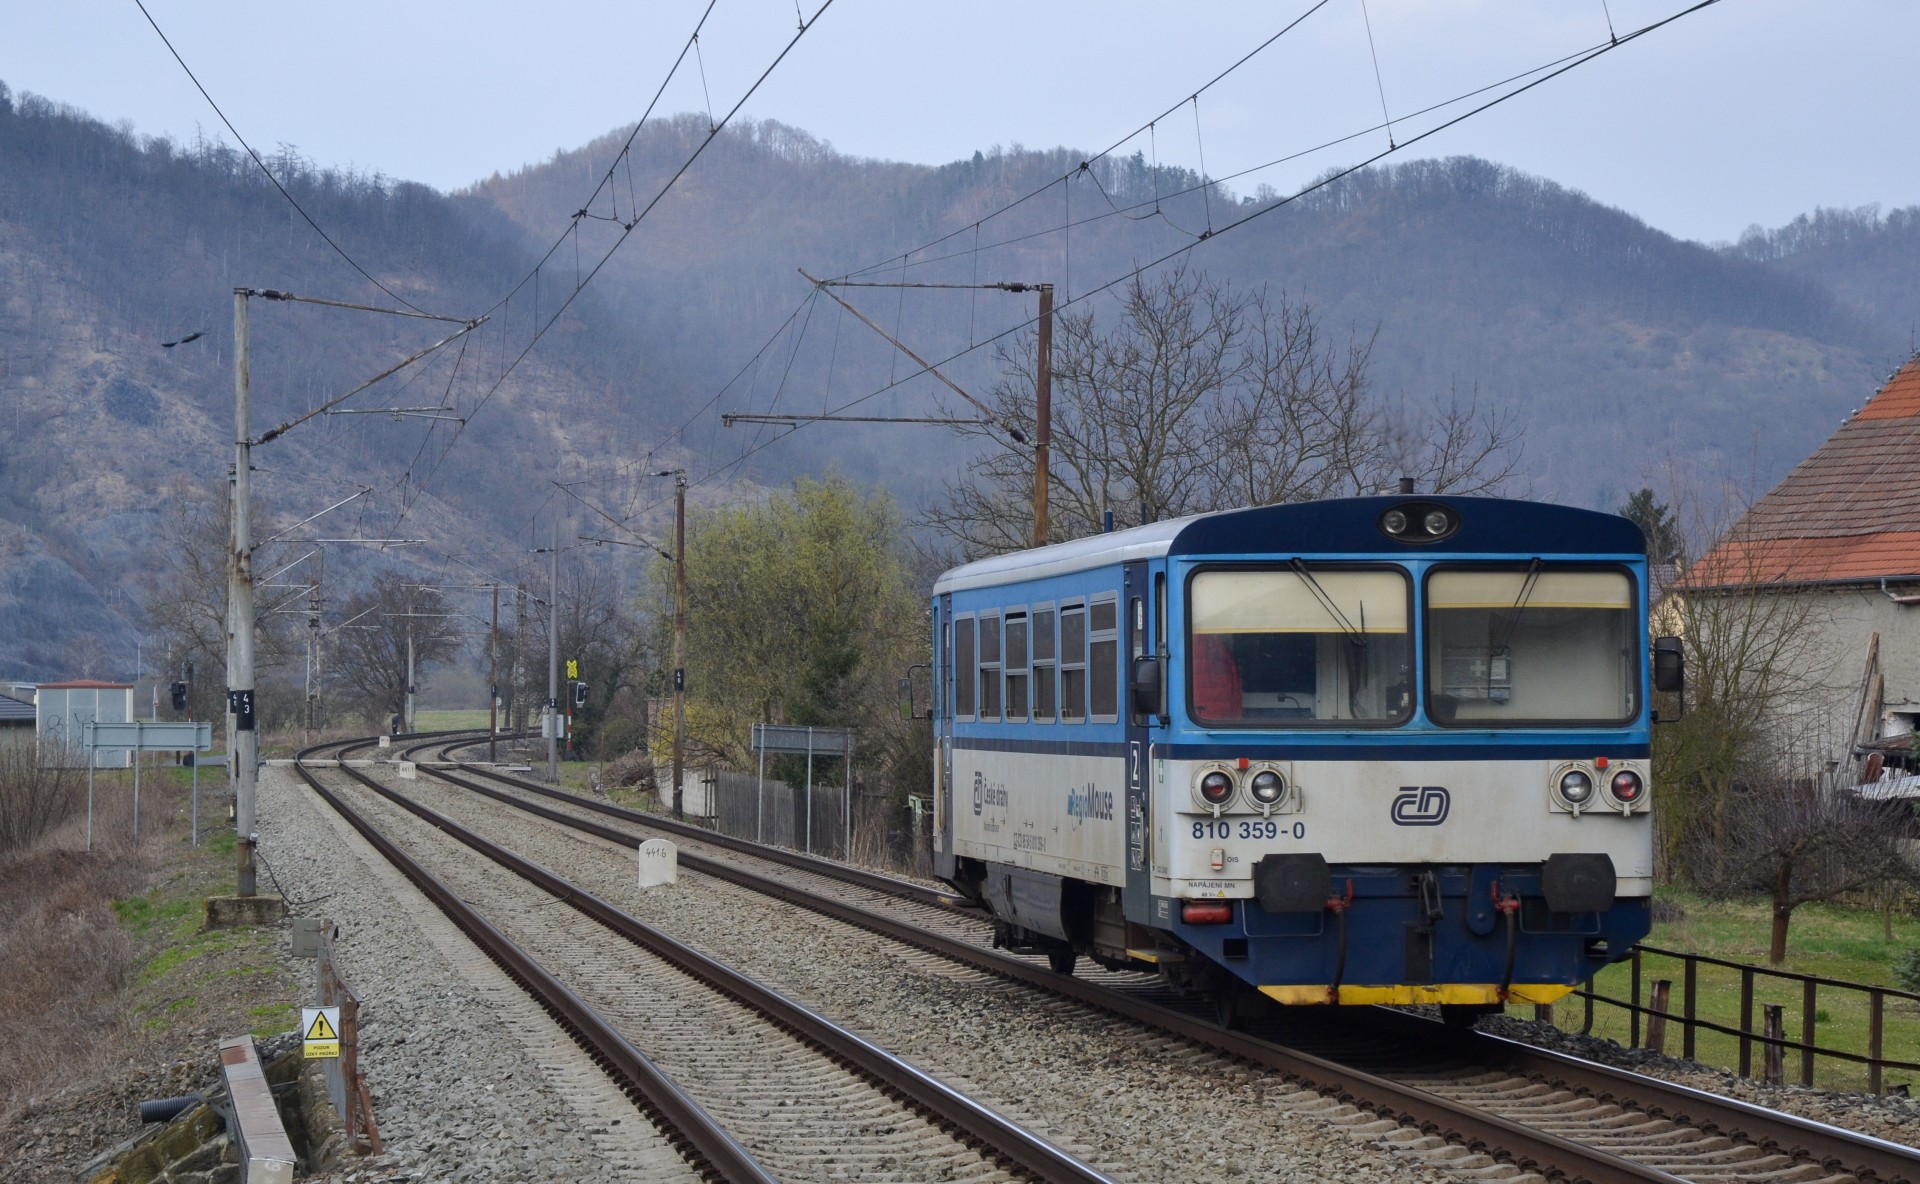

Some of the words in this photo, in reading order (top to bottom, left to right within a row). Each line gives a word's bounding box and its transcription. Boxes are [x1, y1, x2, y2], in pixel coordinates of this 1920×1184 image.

[1133, 749, 1138, 781] 2
[1068, 782, 1113, 822] RegioMouse
[1192, 821, 1230, 840] 810
[1238, 821, 1305, 840] 359-0
[1188, 881, 1222, 889] NAPÁJENÍ
